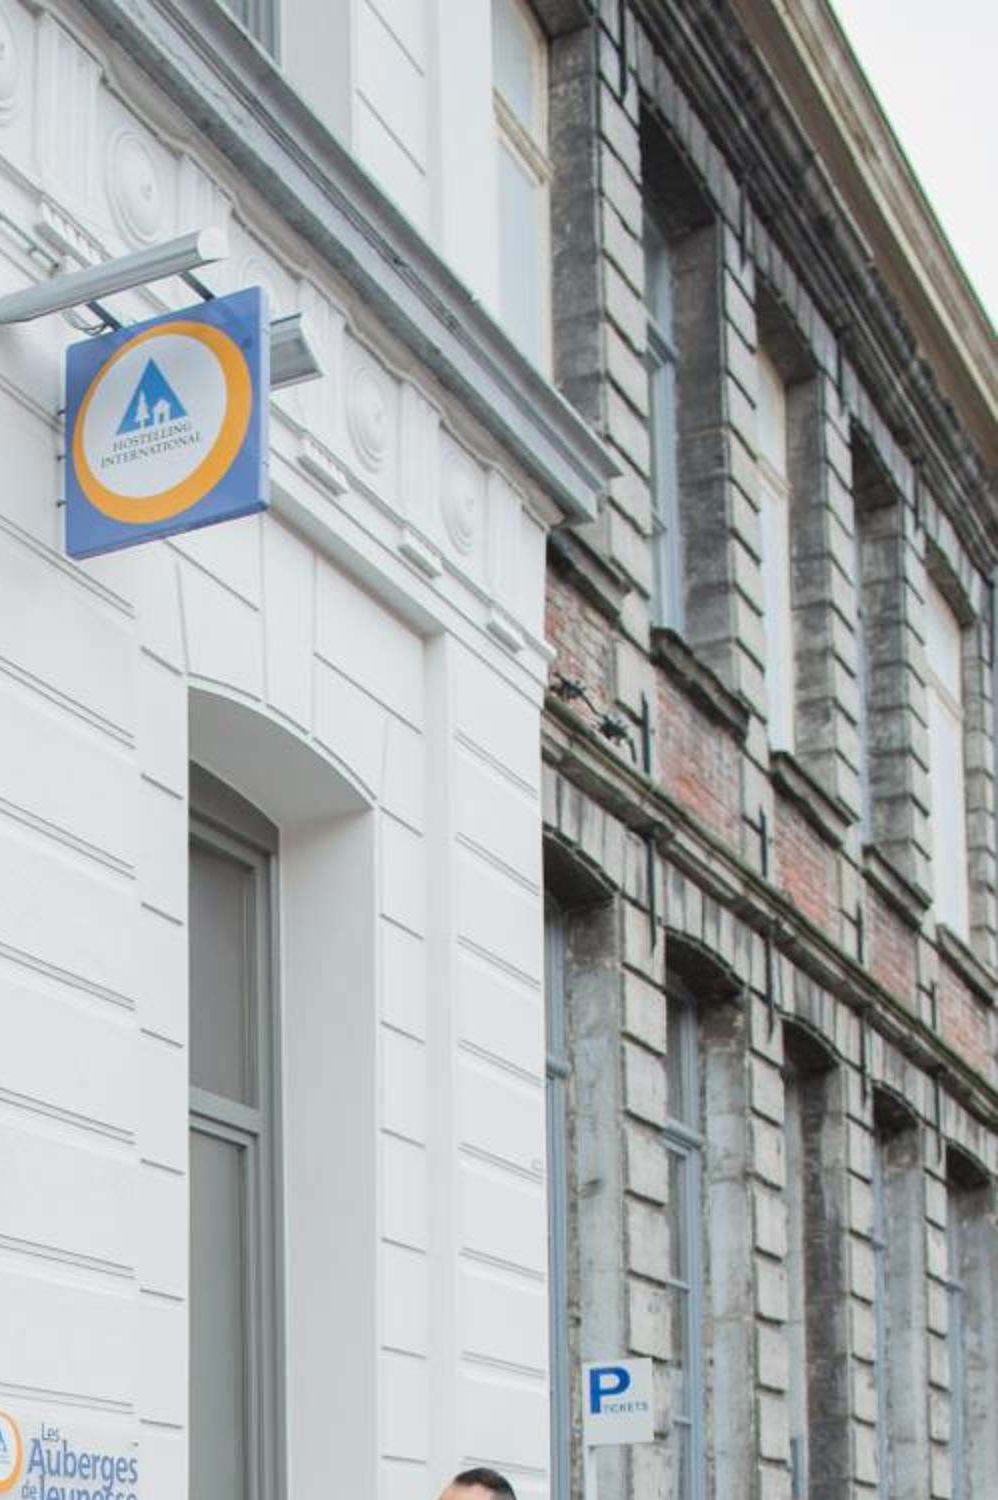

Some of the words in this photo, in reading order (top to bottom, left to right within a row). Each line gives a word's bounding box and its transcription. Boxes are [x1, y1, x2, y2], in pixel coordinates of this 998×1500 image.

[101, 431, 201, 468] INTERNATIONAL
[112, 421, 192, 453] HOSTELLING
[589, 1366, 631, 1414] P
[602, 1401, 649, 1413] TICKETS
[41, 1421, 60, 1442] Les
[27, 1437, 138, 1491] Auberges
[21, 1480, 37, 1500] de
